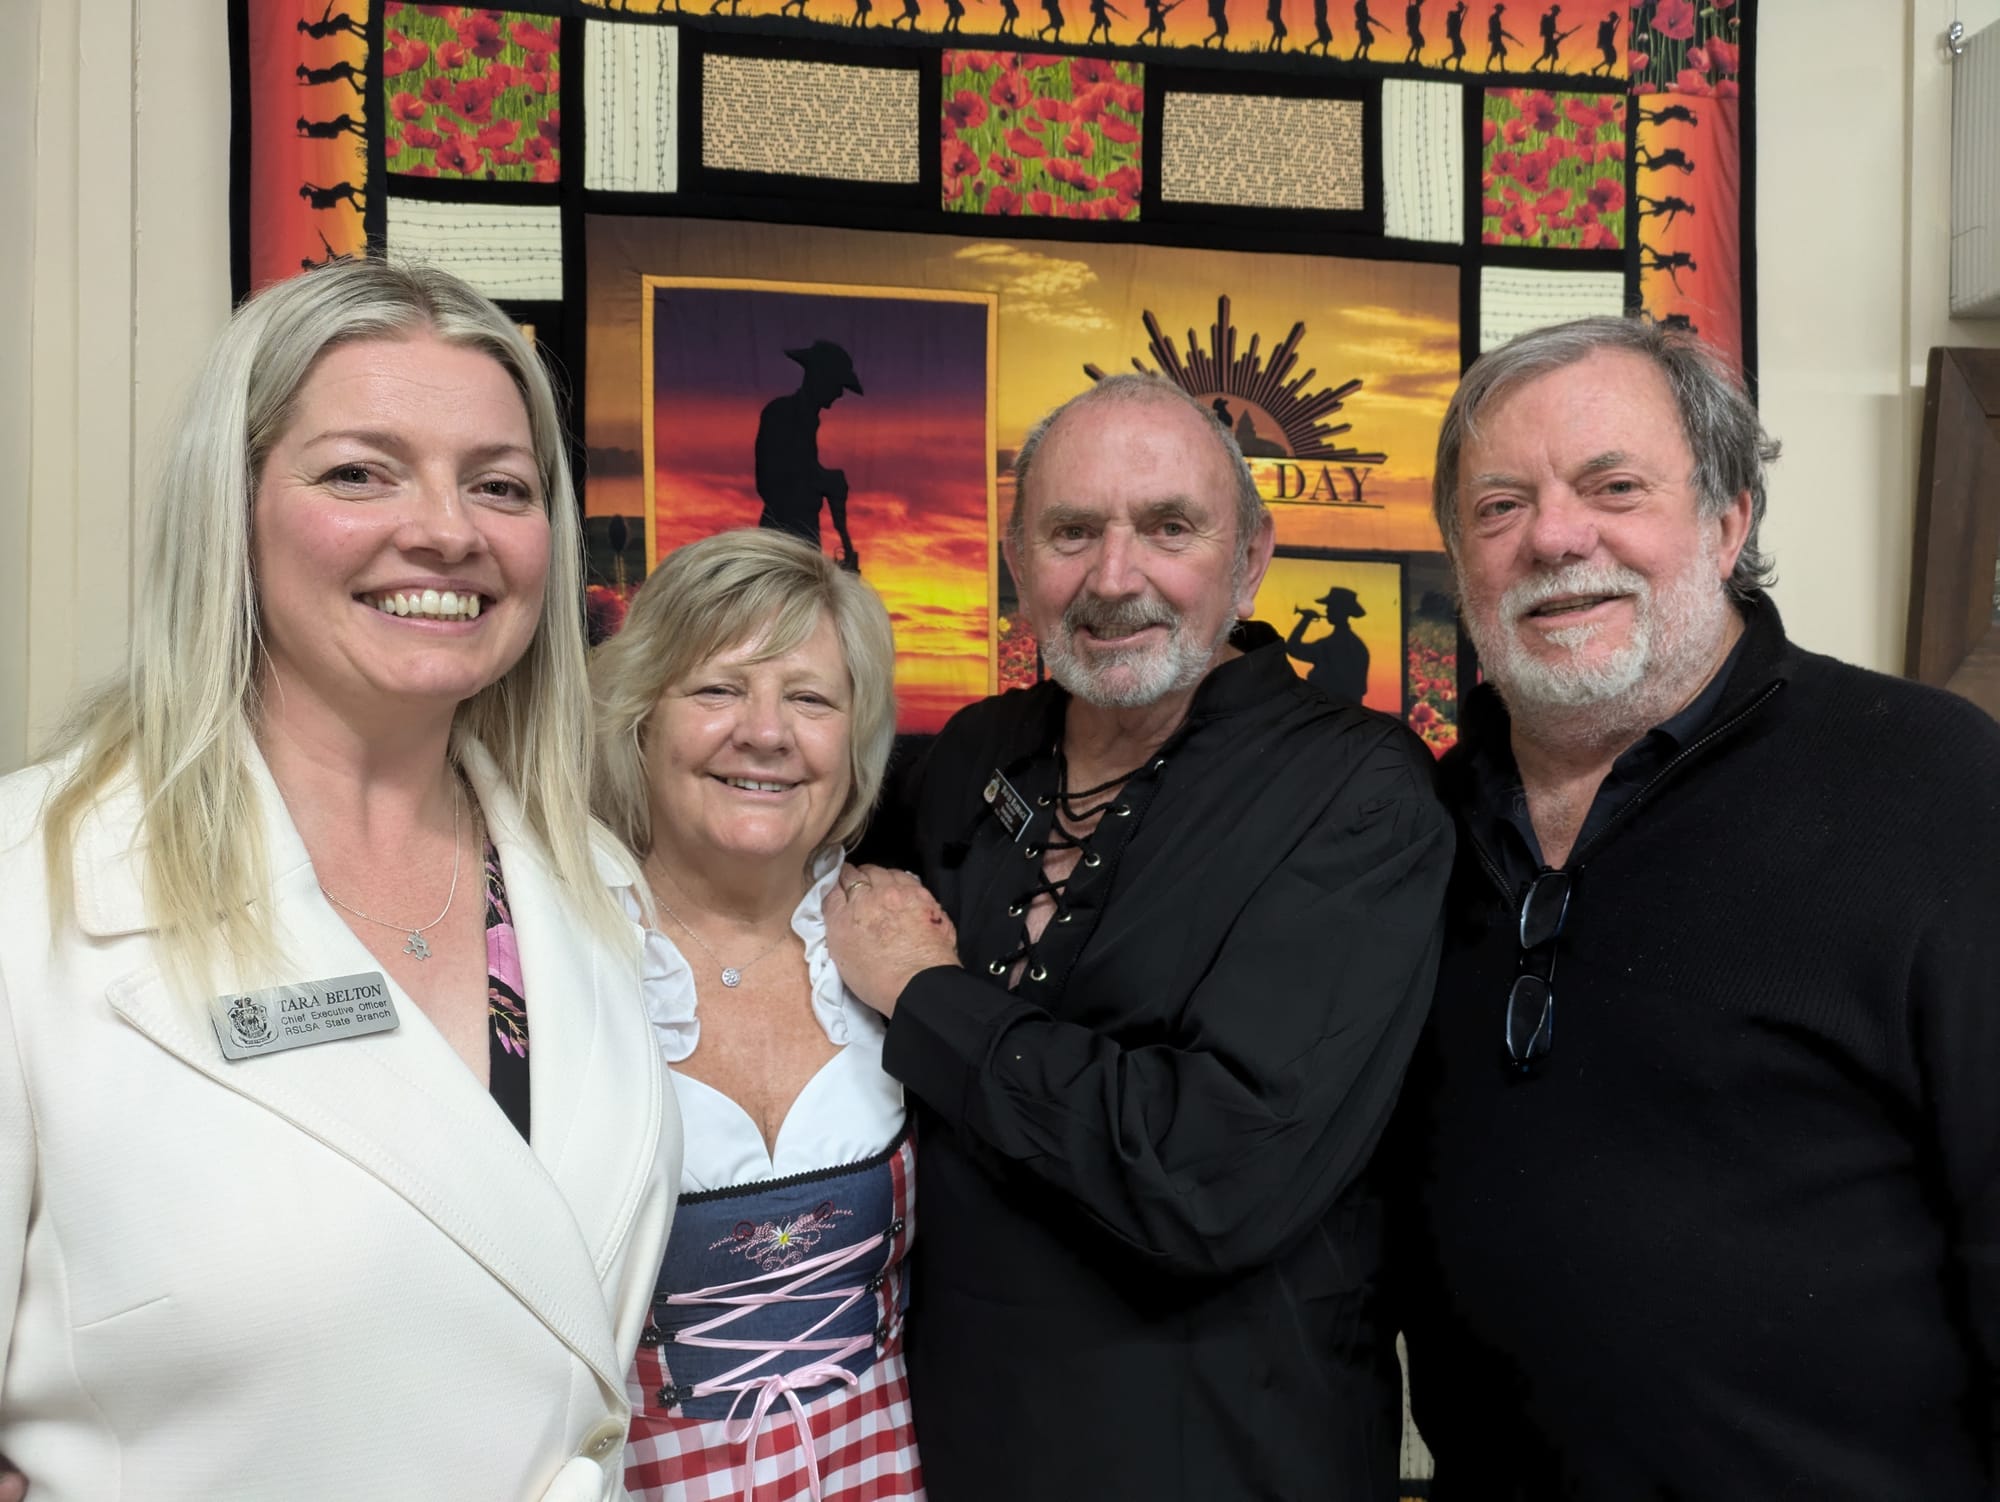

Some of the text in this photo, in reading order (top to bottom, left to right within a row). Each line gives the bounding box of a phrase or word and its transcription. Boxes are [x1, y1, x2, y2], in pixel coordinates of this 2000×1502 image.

[1272, 463, 1373, 502] DAY
[280, 984, 382, 1013] TARA BELTON
[281, 1000, 388, 1026] Chief Executive Officer
[285, 1009, 391, 1036] RSLSA State Branch
